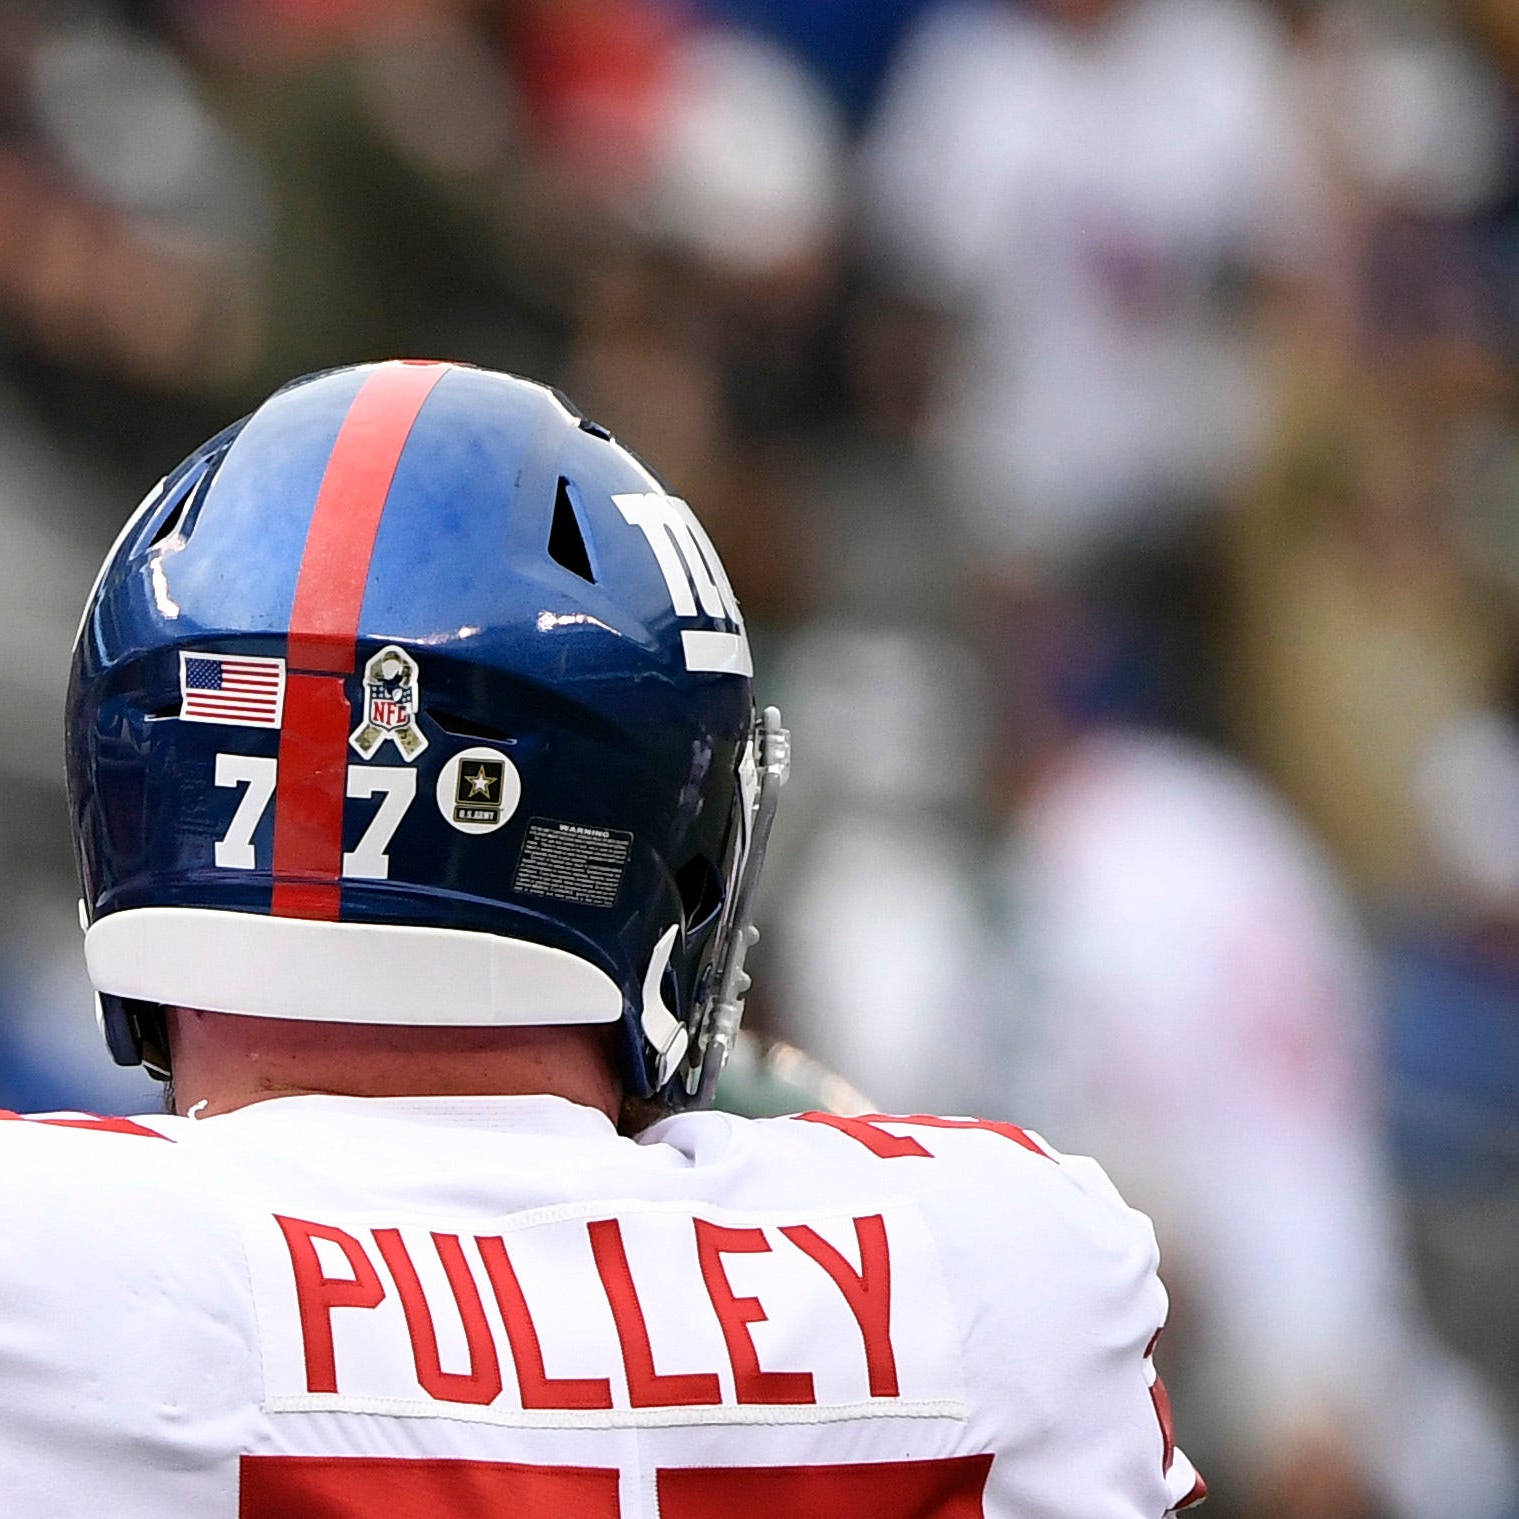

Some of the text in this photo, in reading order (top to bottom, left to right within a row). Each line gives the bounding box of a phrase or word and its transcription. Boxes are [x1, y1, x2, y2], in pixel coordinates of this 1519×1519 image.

[372, 700, 408, 726] NFL
[559, 823, 610, 839] WARNING
[272, 1212, 900, 1411] PULLEY
